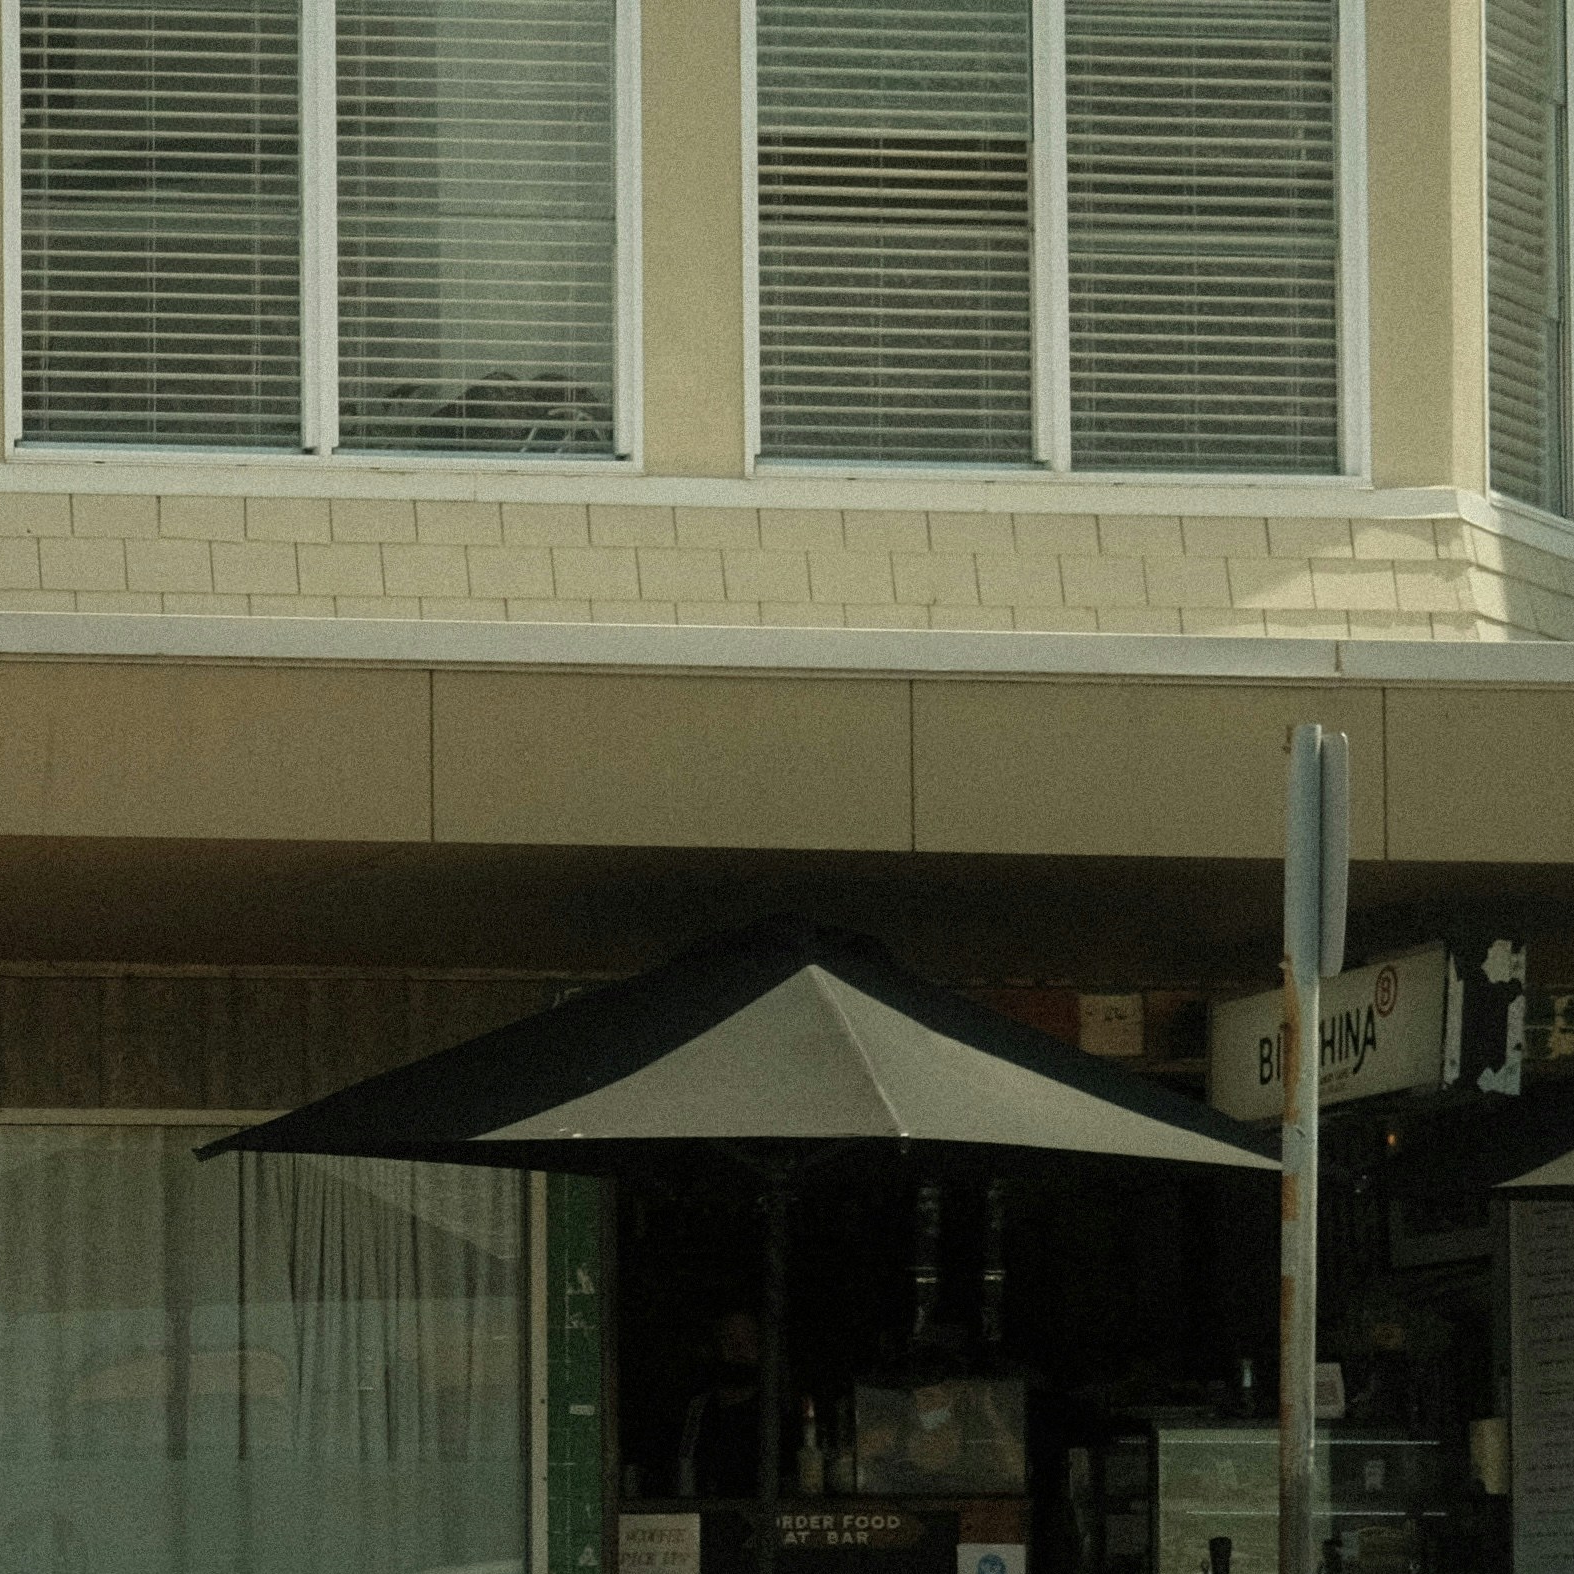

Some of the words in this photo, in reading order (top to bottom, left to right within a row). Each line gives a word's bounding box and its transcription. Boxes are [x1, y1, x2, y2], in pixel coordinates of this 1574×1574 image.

[1259, 1003, 1376, 1085] BIHINA
[842, 1515, 900, 1529] FOOD
[783, 1531, 810, 1544] AT
[826, 1531, 869, 1544] BAR
